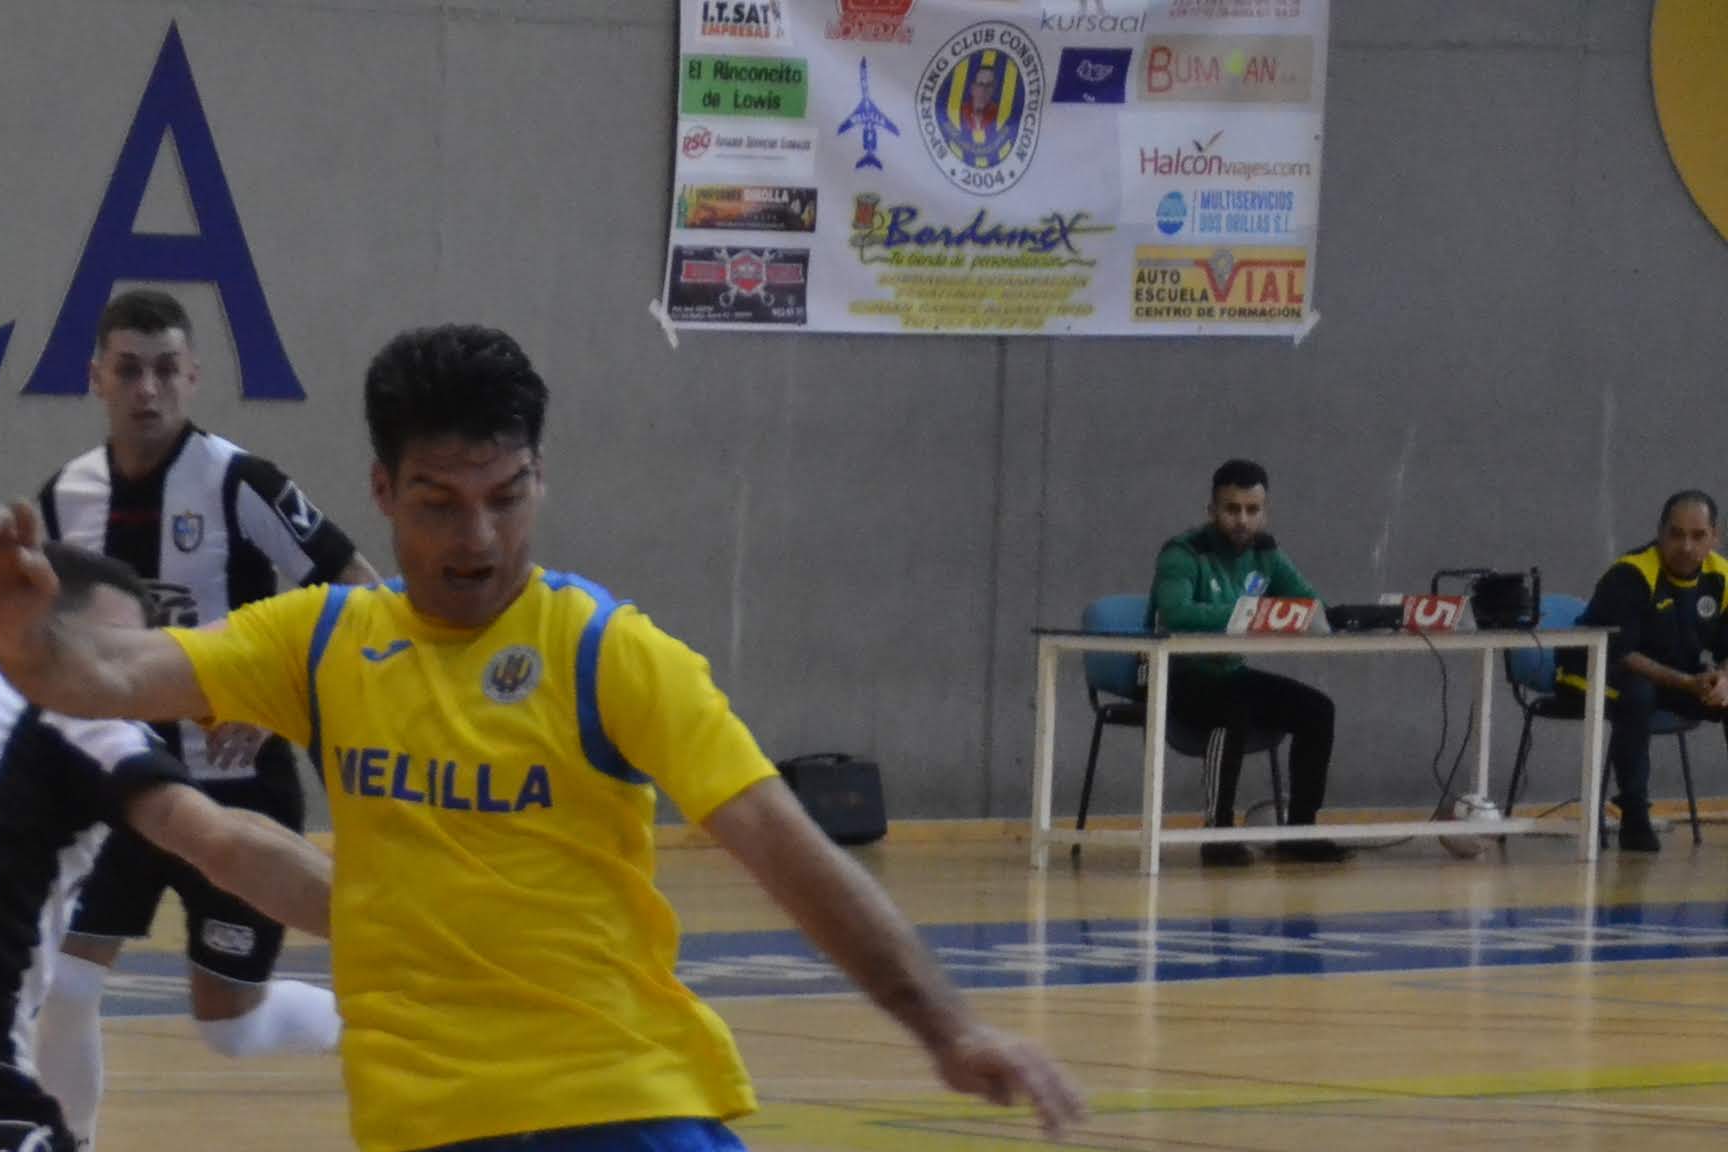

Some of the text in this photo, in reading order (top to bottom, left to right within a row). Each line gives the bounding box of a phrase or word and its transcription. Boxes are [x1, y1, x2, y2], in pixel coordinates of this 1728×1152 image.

[1041, 9, 1146, 33] kursaal
[688, 61, 803, 84] El Rinconcito
[920, 57, 949, 160] SPORTING
[951, 28, 995, 57] CLUB
[961, 170, 1005, 189] 2004
[1200, 189, 1295, 212] MULTISERVICIOS
[1136, 269, 1181, 285] AUTO
[1193, 259, 1305, 304] VIAL
[1135, 288, 1209, 303] ESCUELA
[1135, 306, 1193, 318] CENTRO
[1199, 307, 1216, 318] DE
[334, 746, 552, 813] MELILLA
